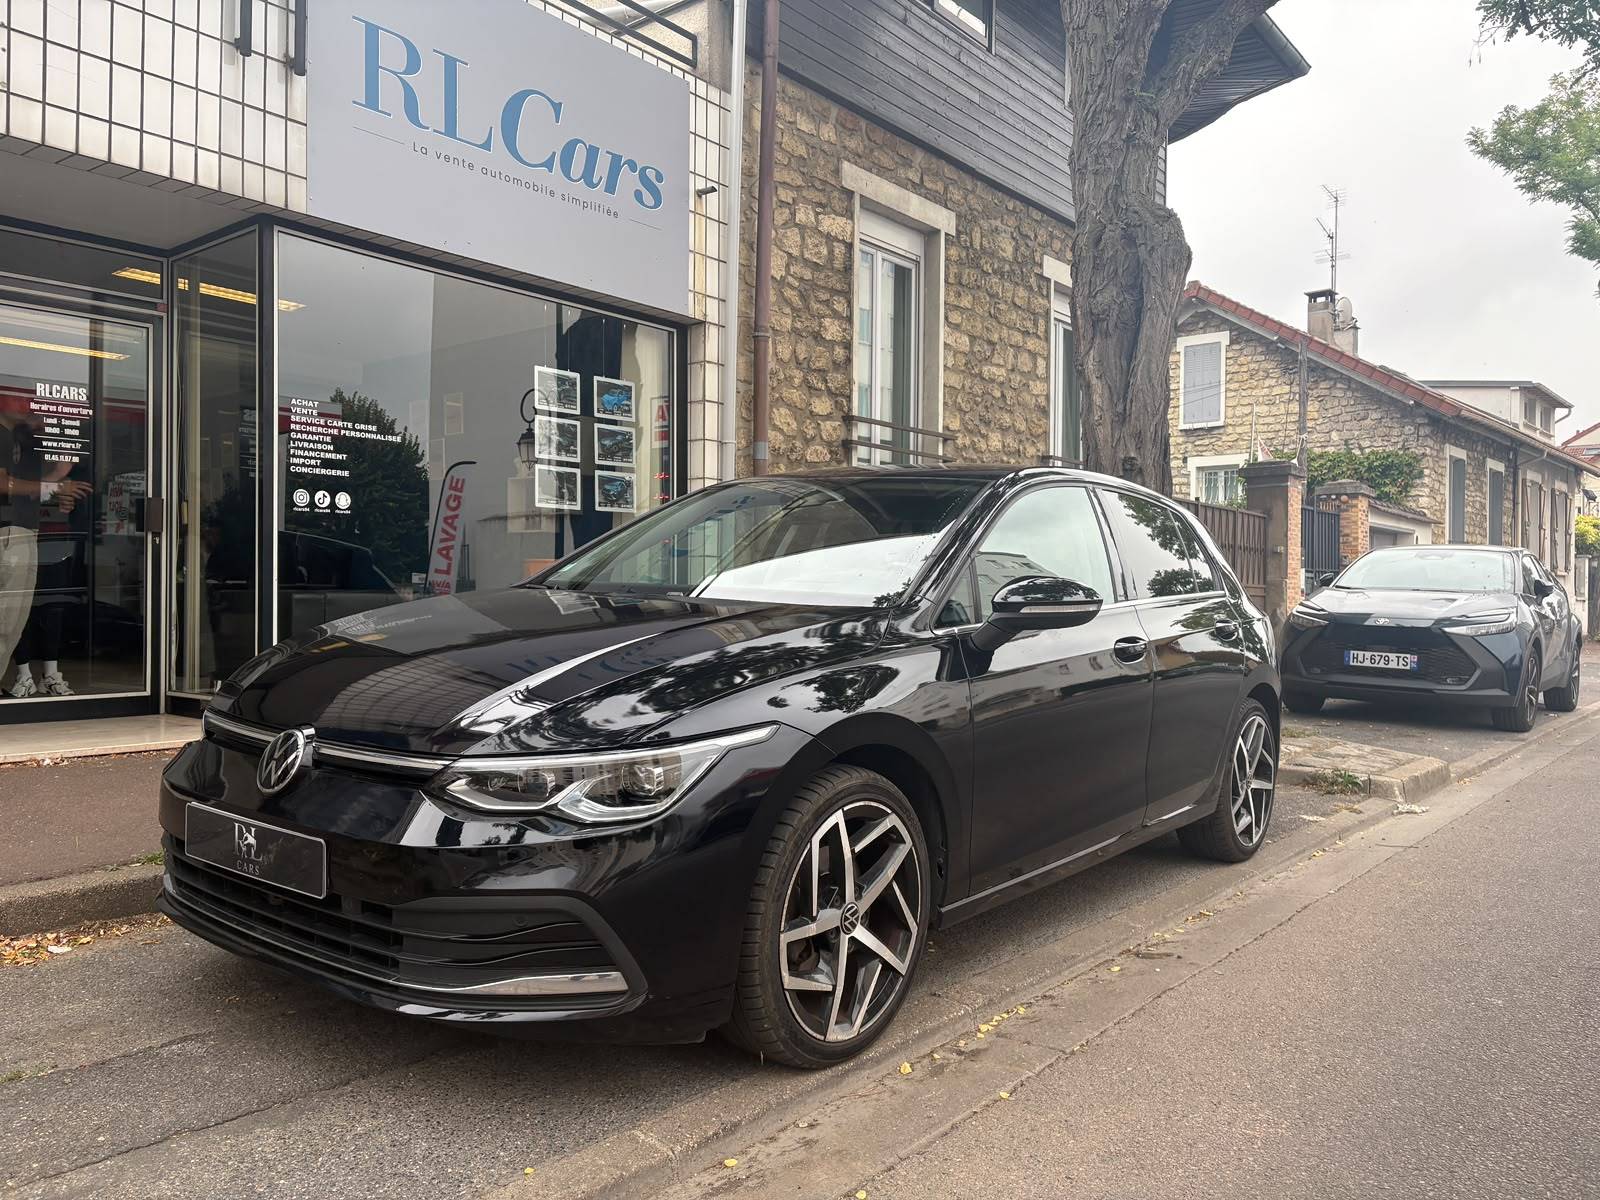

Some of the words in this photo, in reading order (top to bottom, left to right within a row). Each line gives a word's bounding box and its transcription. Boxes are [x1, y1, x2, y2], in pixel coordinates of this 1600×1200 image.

[412, 141, 429, 156] La
[435, 151, 475, 171] vente
[480, 166, 556, 198] automobile
[560, 192, 619, 219] simplifiée
[36, 382, 87, 401] RLCARS
[30, 402, 57, 412] Horaires
[58, 404, 93, 416] d'ouverture
[291, 398, 319, 408] ACHAT
[290, 406, 318, 416] VENTE
[290, 415, 326, 426] SERVICE
[327, 419, 353, 429] CARTE
[354, 423, 378, 432] GRISE
[290, 423, 339, 436] RECHERCHE
[290, 432, 332, 442] GARANTIE
[42, 440, 82, 450] www.rlcars.fr
[290, 440, 334, 451] LIVRAISON
[290, 448, 348, 461] FINANCEMENT
[290, 457, 321, 467] IMPORT
[290, 465, 350, 477] CONCIERGERIE
[434, 476, 465, 576] LAVAGE
[236, 859, 261, 876] CARS
